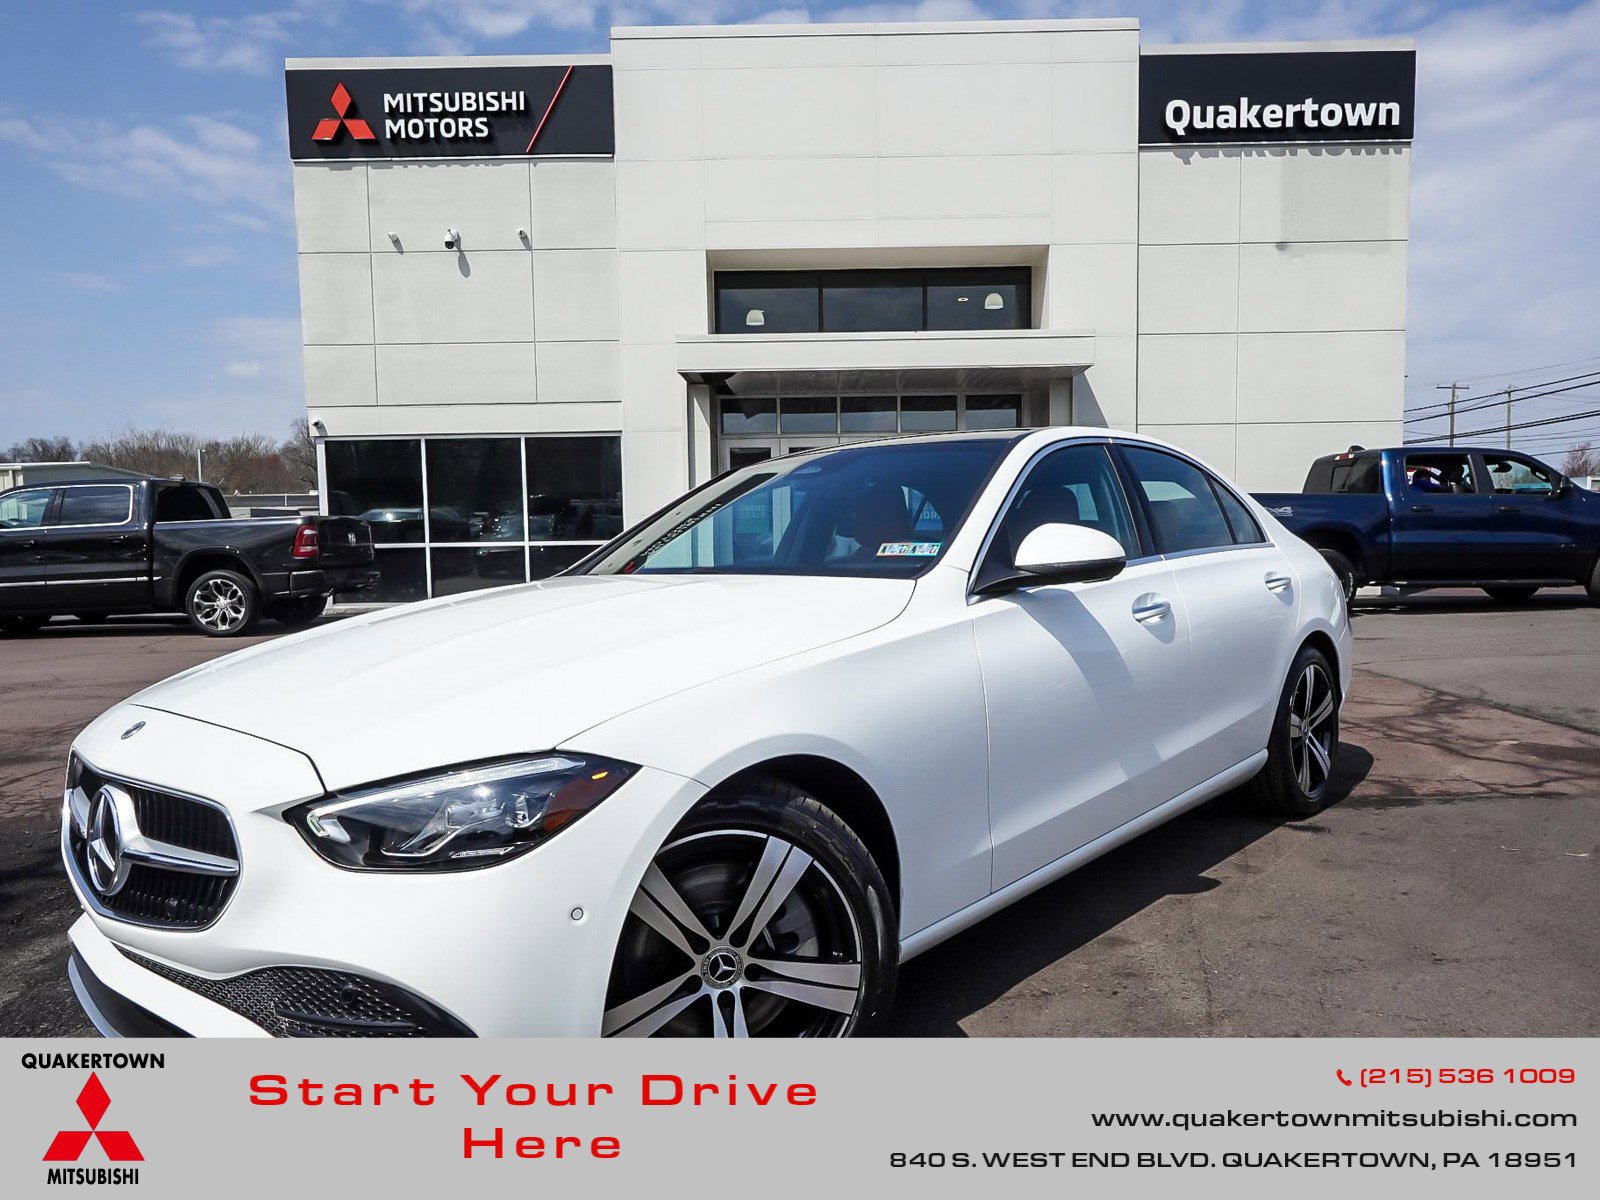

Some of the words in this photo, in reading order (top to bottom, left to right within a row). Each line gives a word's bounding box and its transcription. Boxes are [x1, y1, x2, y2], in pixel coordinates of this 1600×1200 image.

[383, 91, 525, 113] MITSUBISHI
[1165, 97, 1400, 136] Quakertown
[385, 117, 489, 139] MOTORS
